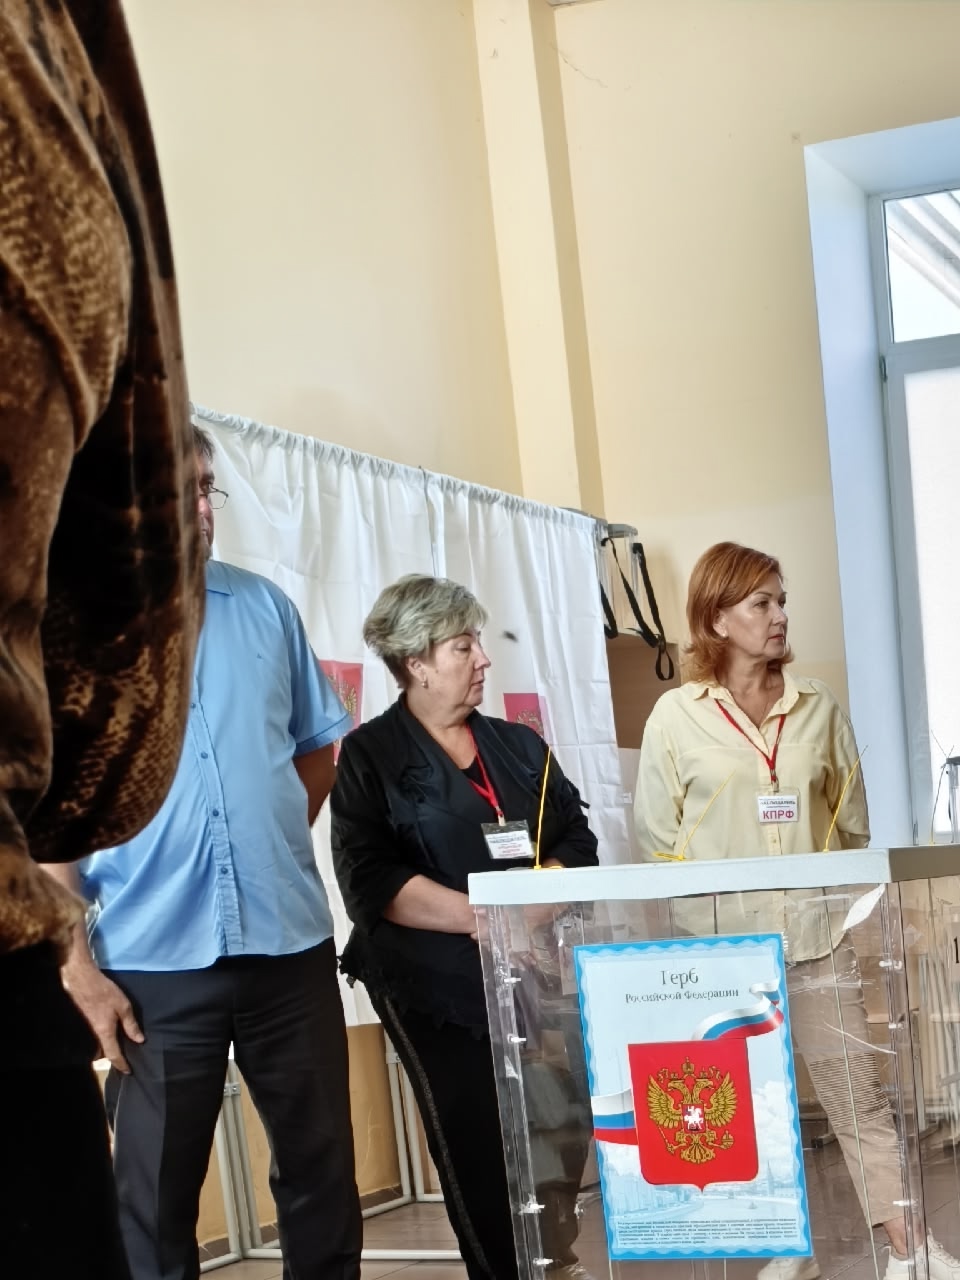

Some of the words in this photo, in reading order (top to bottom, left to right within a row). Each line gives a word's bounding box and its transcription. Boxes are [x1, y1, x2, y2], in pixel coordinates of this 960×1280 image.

[763, 810, 795, 820] КПРФ
[661, 967, 699, 989] Герб
[625, 991, 682, 1003] Российской
[684, 989, 739, 1001] Федерации
